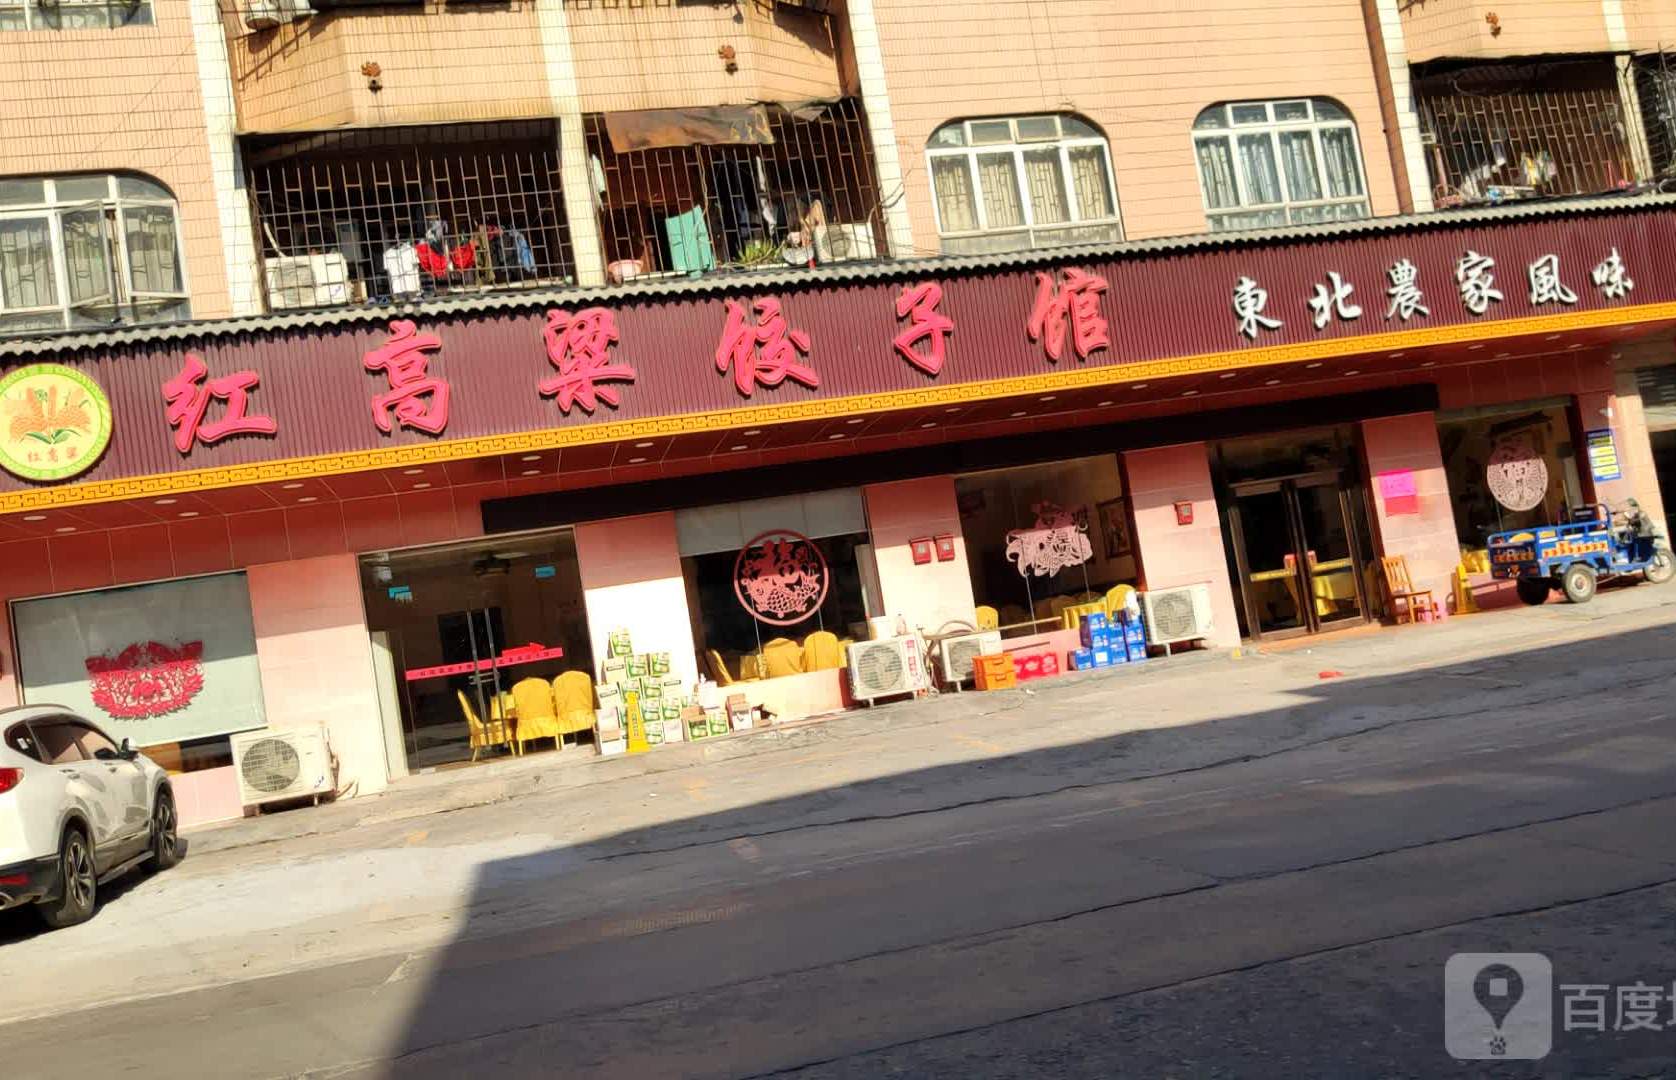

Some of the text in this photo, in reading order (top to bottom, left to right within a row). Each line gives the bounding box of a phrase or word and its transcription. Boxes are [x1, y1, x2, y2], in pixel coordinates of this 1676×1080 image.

[1233, 246, 1635, 340] 東北農家風味
